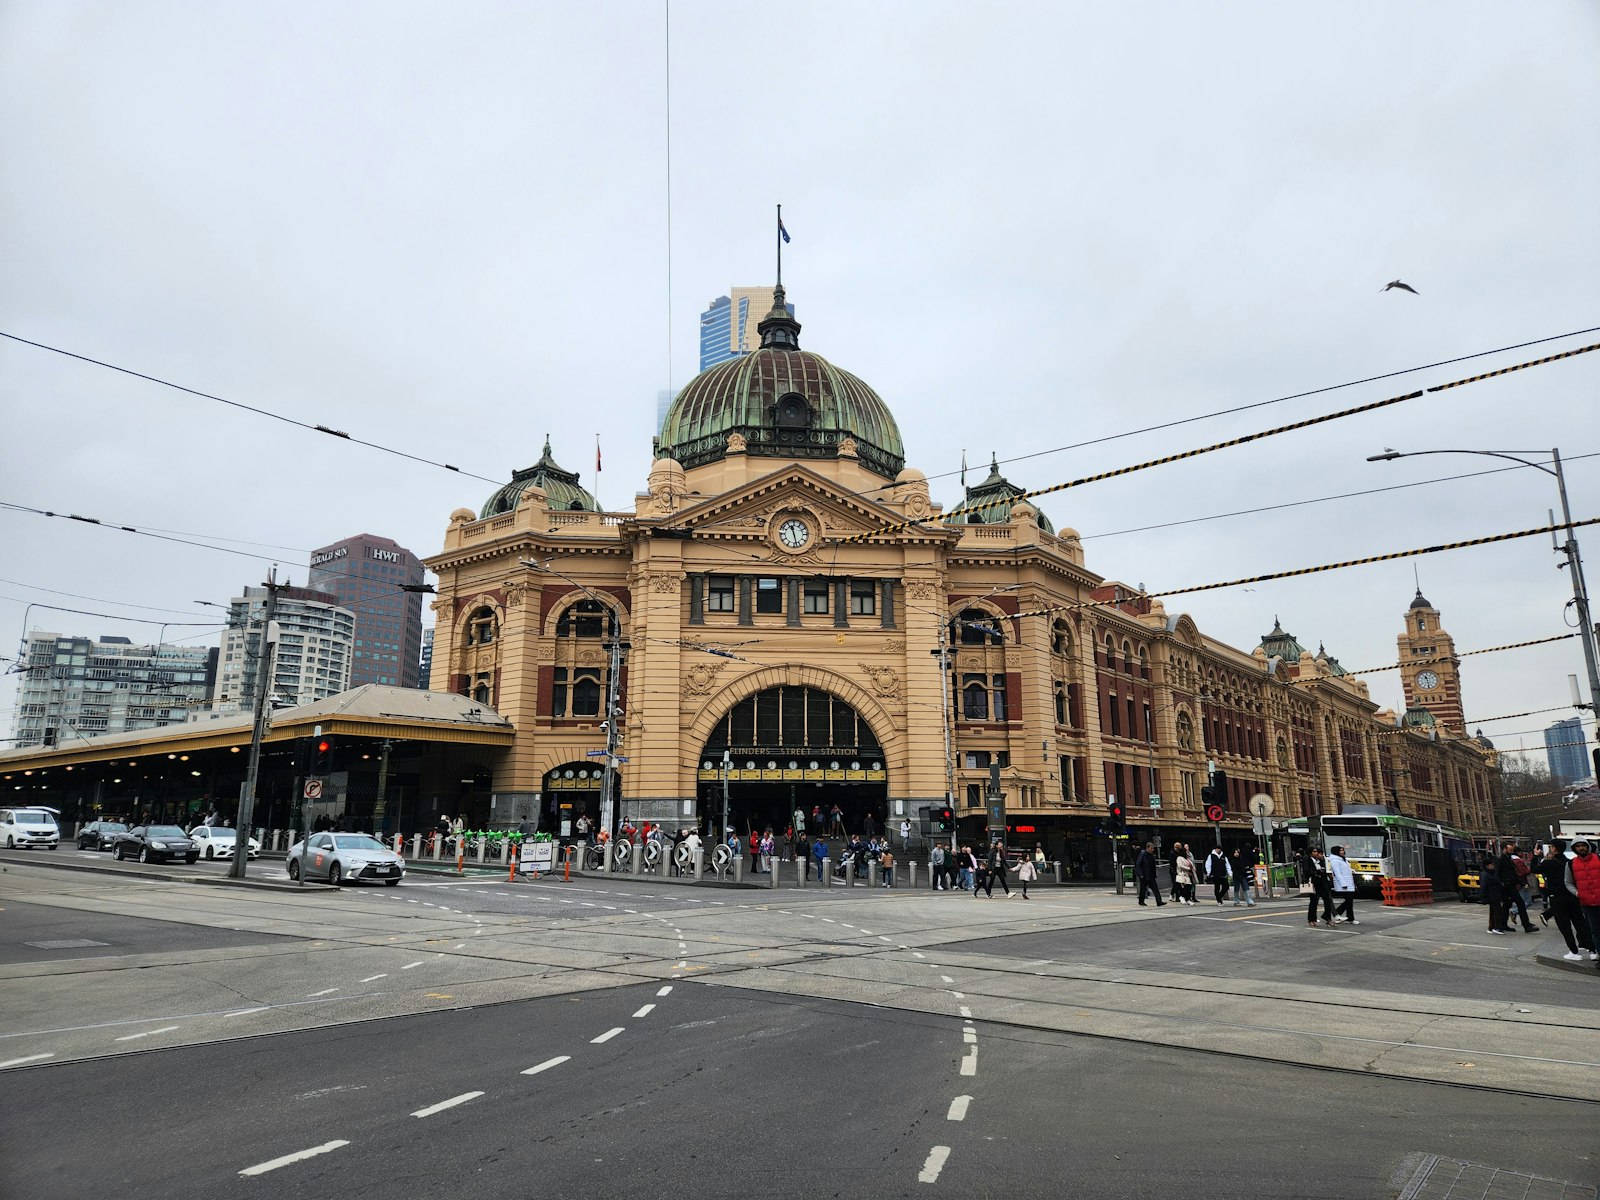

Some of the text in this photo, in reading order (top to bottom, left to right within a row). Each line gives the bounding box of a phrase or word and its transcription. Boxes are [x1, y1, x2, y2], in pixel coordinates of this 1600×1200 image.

[334, 547, 348, 558] SUN
[373, 549, 400, 563] HWT
[729, 747, 858, 756] FLINDERS STREET STATION
